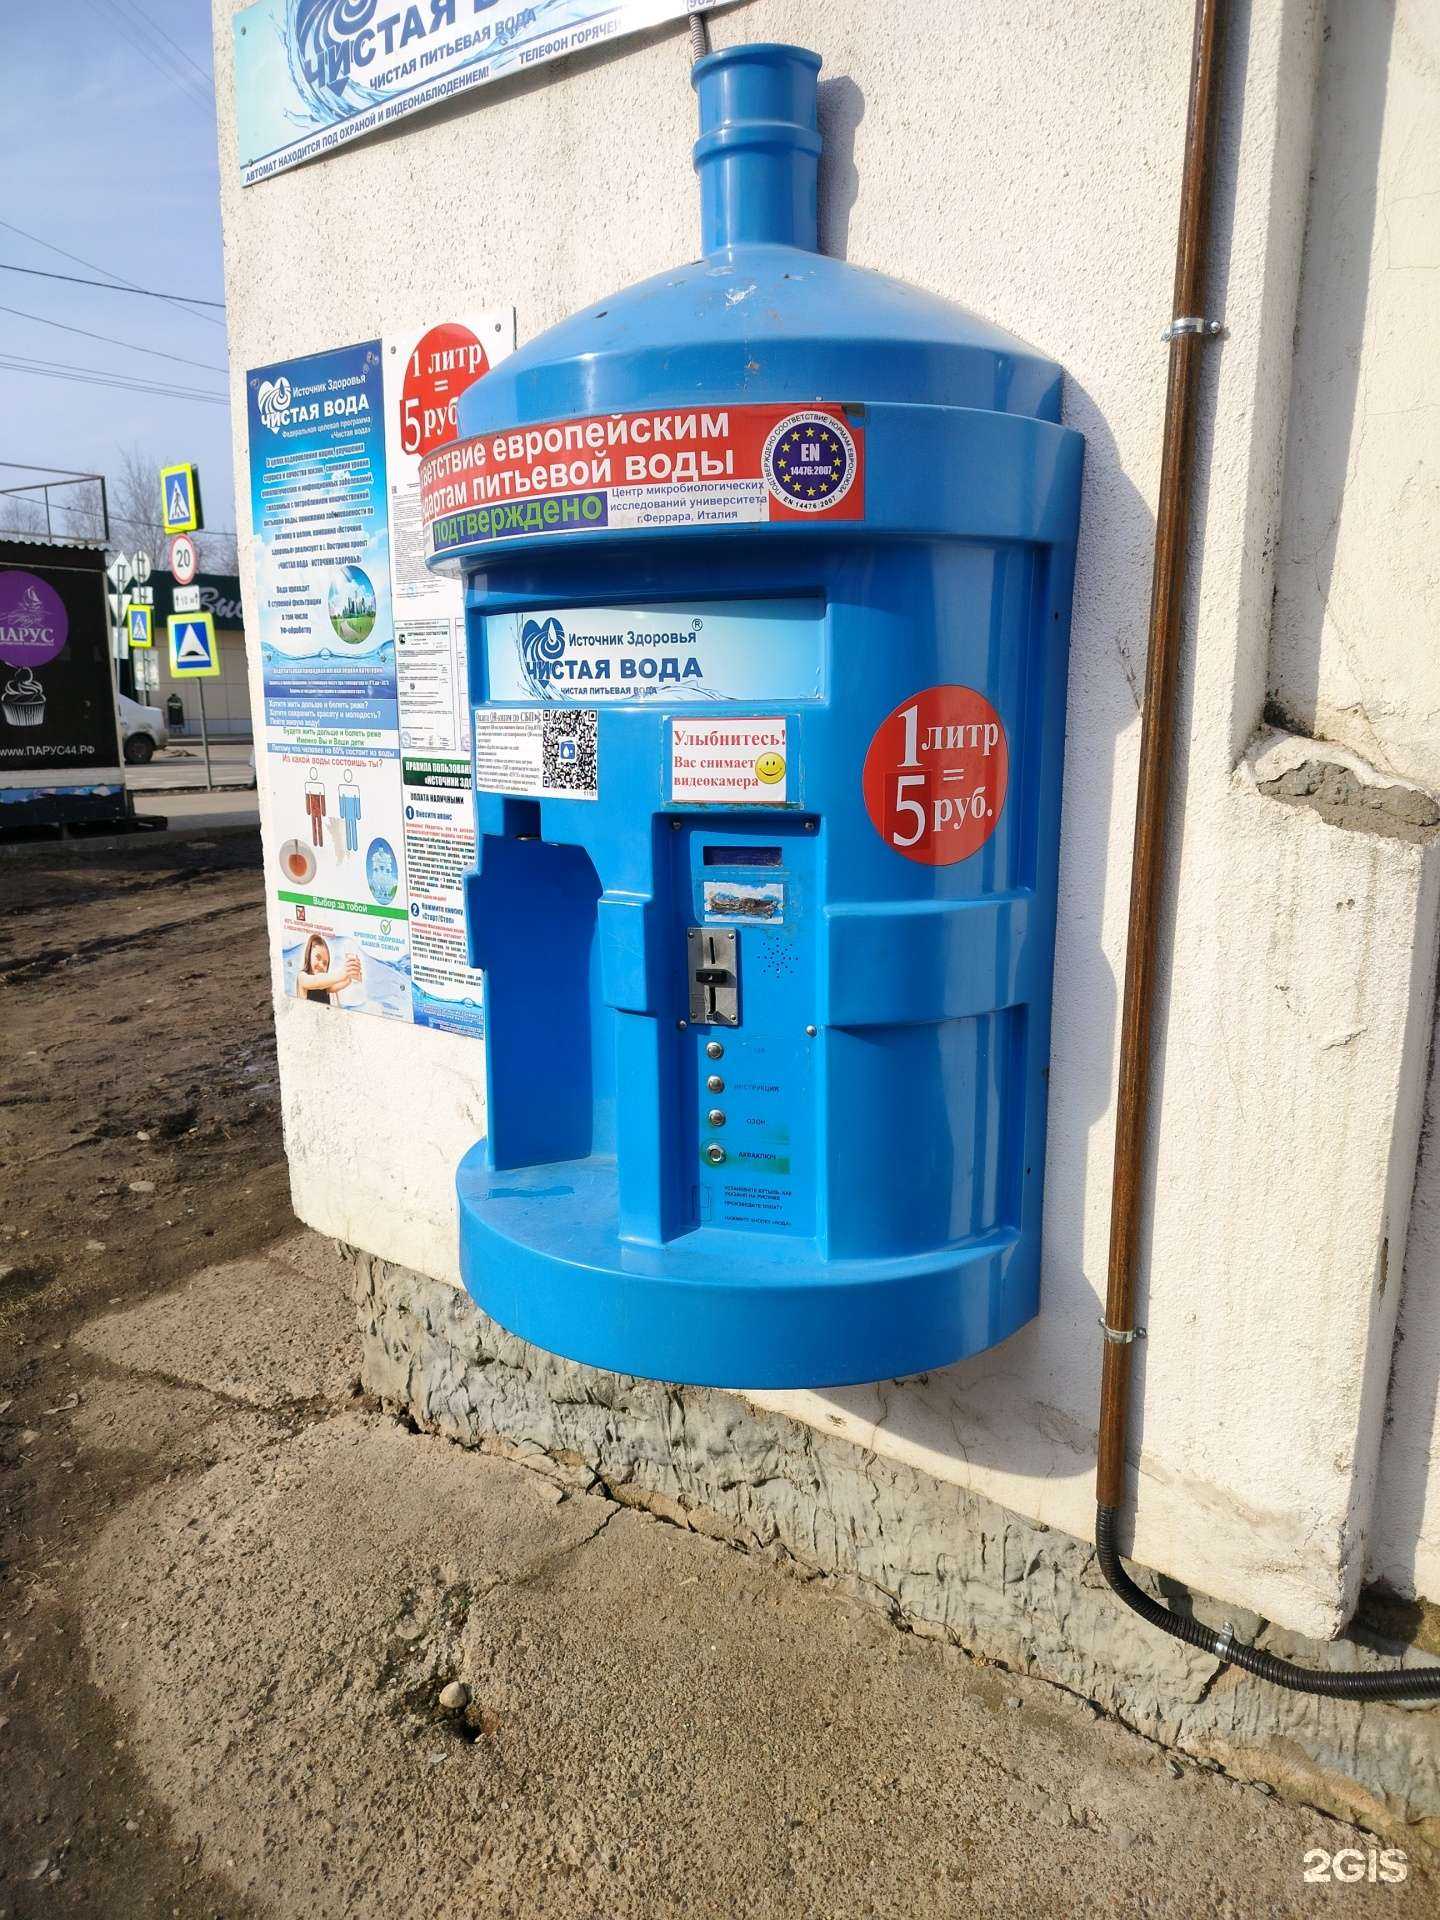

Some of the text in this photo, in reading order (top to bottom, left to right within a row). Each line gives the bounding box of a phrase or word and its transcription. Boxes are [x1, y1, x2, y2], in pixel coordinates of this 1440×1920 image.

[304, 0, 456, 88] ЧИСТАЯ
[370, 8, 537, 90] ЧИСТАЯ ПИТЬЕВАЯ ВОДА
[519, 36, 568, 64] ТЕЛЕФОН
[246, 66, 489, 184] АВТОМАТ НАХОДИТСЯ ПОД ОХРАНОЙ И ВИДЕОНАБЛЮДЕНИЕМ!
[412, 344, 482, 377] 1 литр
[292, 375, 366, 398] Источник Здоровья
[261, 394, 370, 428] ЧИСТАЯ ВОДА
[405, 398, 421, 452] 5
[494, 412, 729, 464] европейским
[801, 443, 820, 461] EN
[472, 449, 612, 498] питьевой
[625, 449, 734, 483] воды
[790, 465, 832, 476] 14476:2007
[612, 481, 764, 498] Центр микробиологических
[783, 495, 794, 505] EN
[690, 495, 767, 509] университета
[434, 495, 603, 545] подтверждено
[697, 510, 738, 520] Италия
[176, 549, 191, 568] 20
[569, 632, 623, 646] Источник
[527, 657, 703, 683] ЧИСТАЯ ВОДА
[560, 685, 658, 697] ЧИСТАЯ ПИТЬЕВАЯ ВОДА
[674, 729, 786, 746] Улыбнитесь!
[897, 704, 999, 767] 1 литр
[674, 756, 756, 769] Вас снимает
[674, 777, 759, 790] видеокамера
[893, 775, 993, 847] 5 руб.
